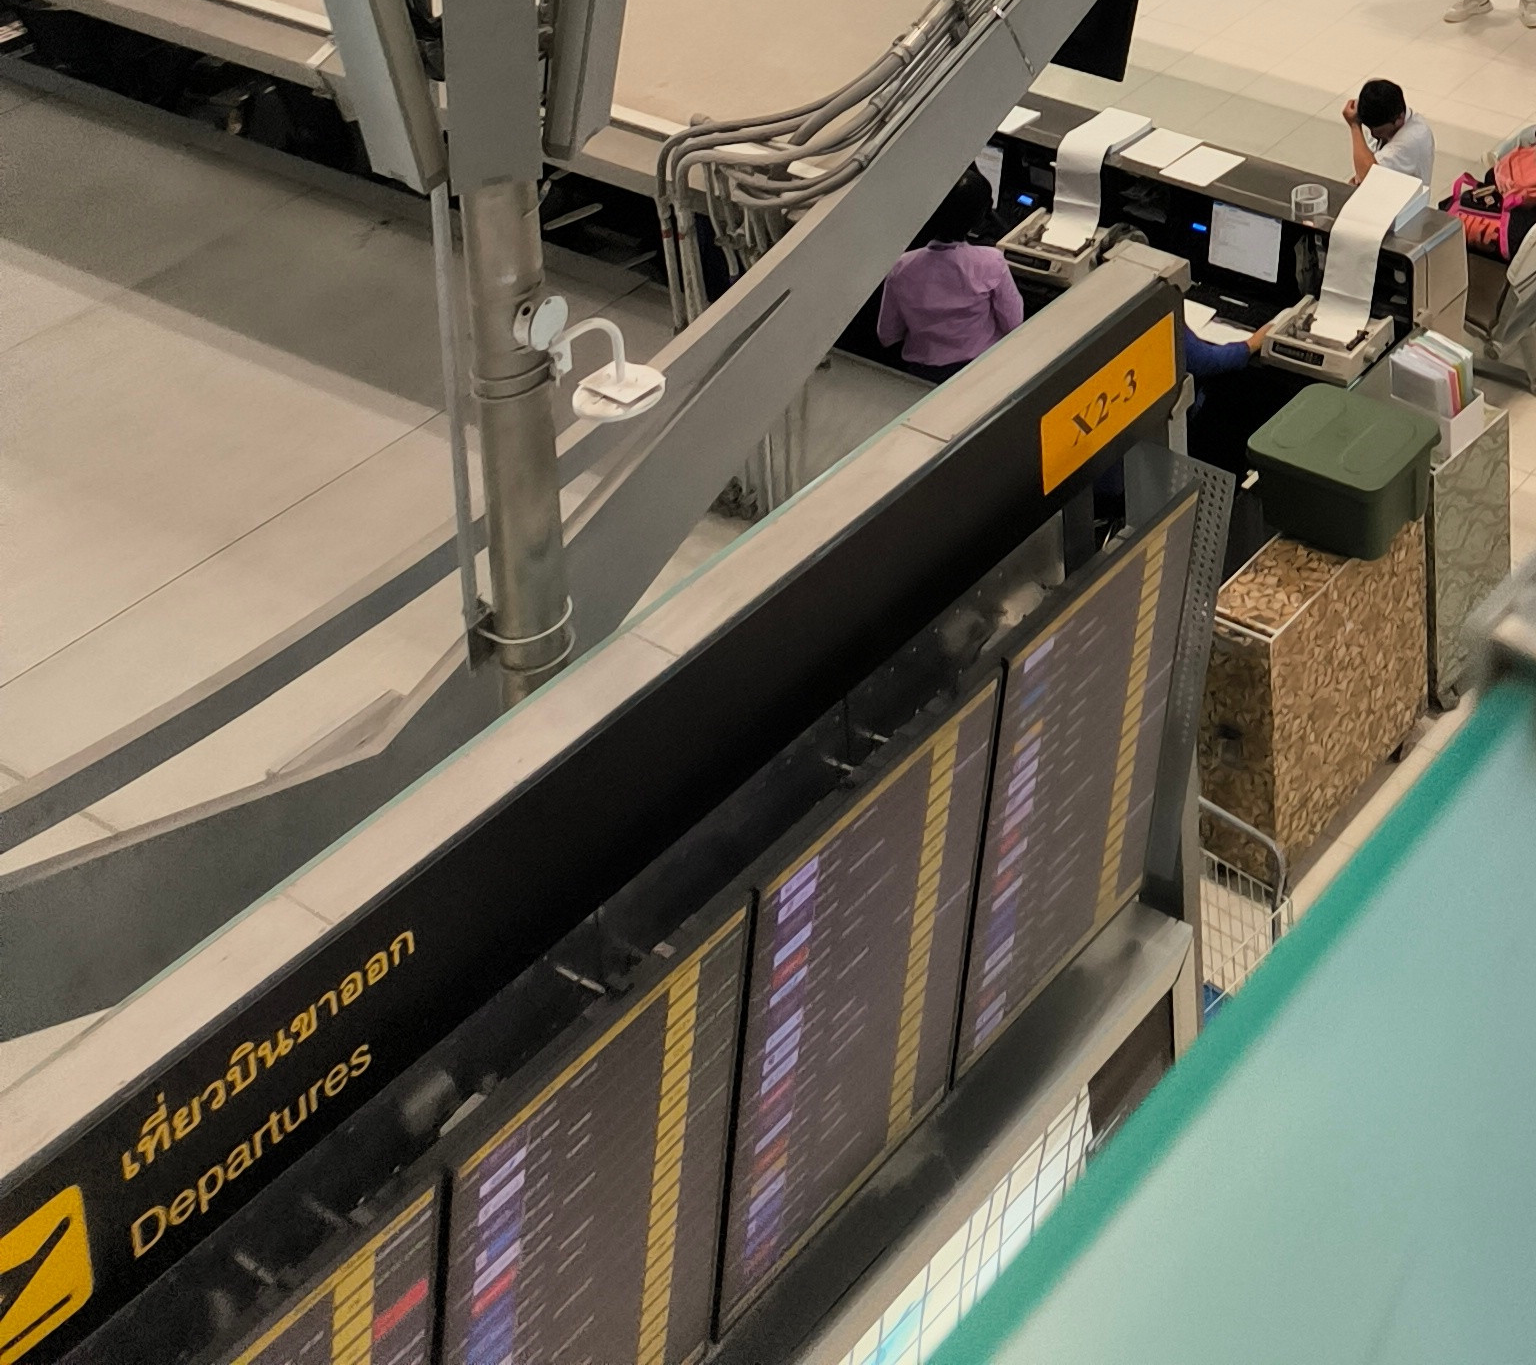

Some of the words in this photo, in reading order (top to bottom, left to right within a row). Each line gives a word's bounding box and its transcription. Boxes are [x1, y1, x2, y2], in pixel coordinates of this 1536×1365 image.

[1071, 367, 1138, 448] X2-3
[119, 926, 417, 1183] เที่ยวบินขาออก
[128, 1041, 374, 1260] Departures
